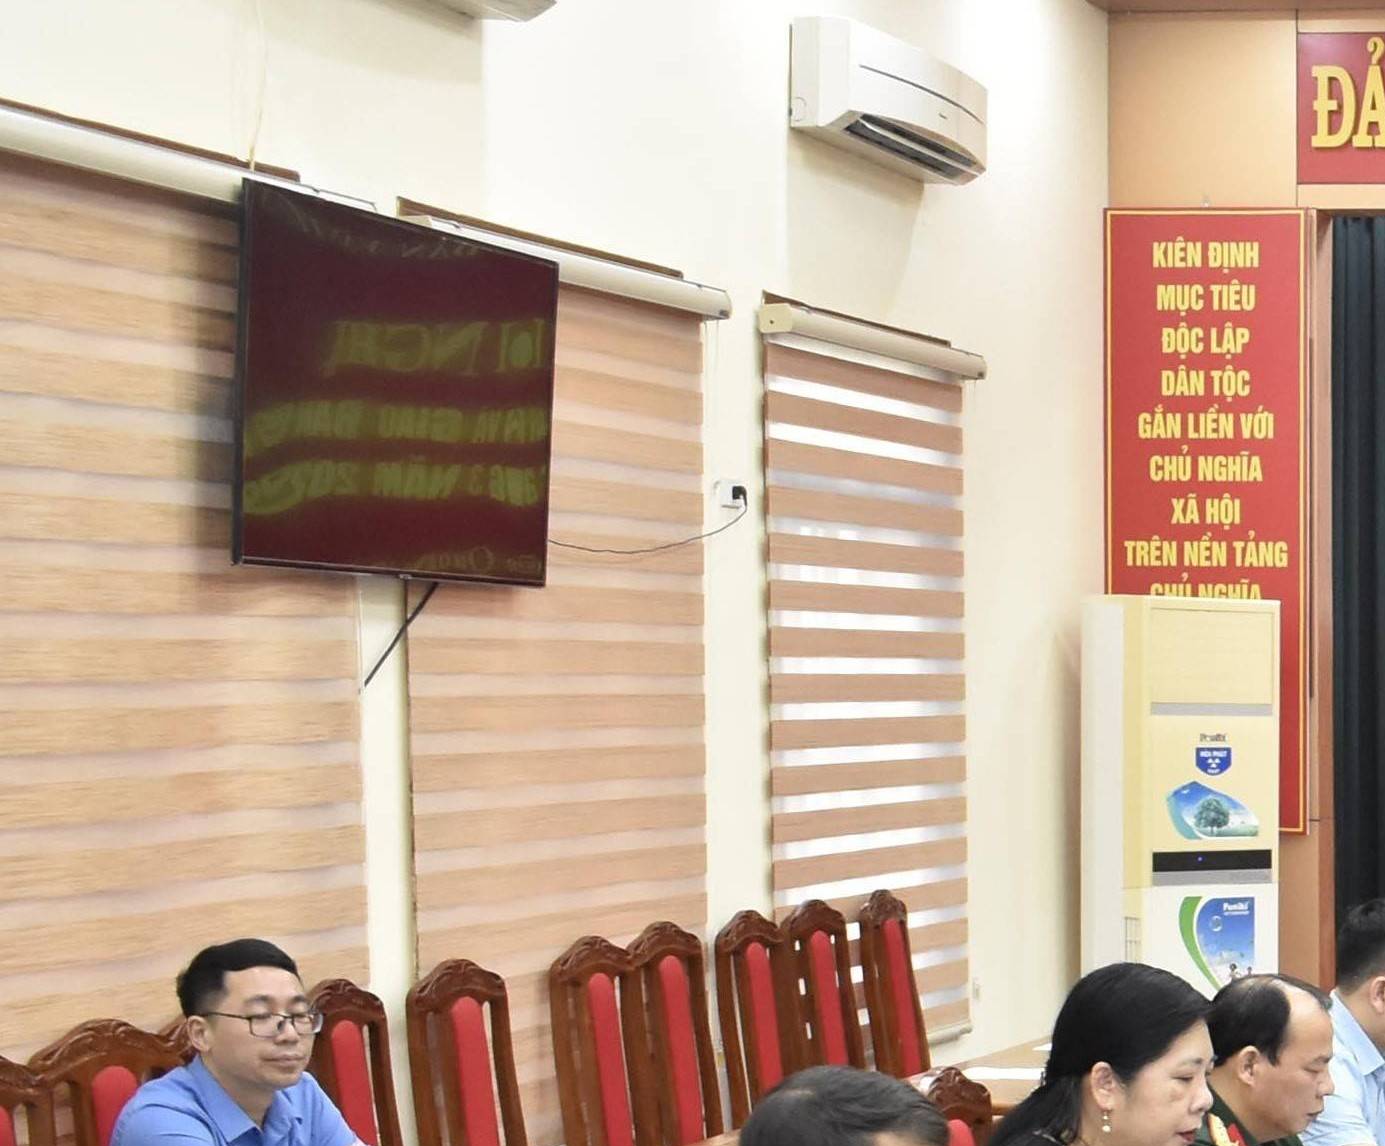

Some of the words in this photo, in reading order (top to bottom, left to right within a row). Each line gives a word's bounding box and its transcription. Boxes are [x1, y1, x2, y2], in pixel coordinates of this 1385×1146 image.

[1153, 236, 1202, 267] KIÊN
[1208, 242, 1259, 273] ĐỊNH
[1157, 284, 1204, 316] MỤC
[1210, 279, 1255, 311] TIÊU
[1162, 322, 1204, 359] ĐỘC
[1211, 322, 1250, 359] LẬP
[1162, 365, 1204, 396] DÂN
[1211, 365, 1250, 402] TỘC
[1139, 405, 1181, 438] GẮN
[1188, 404, 1233, 439] LIỀN
[1240, 406, 1274, 439] VỚI
[1150, 445, 1191, 481] CHỦ
[1198, 451, 1262, 481] NGHĨA
[1172, 494, 1199, 523] XÃ
[1206, 493, 1240, 529] HỘI
[1125, 536, 1177, 566] TRÊN
[1184, 532, 1226, 566] NỀN
[1233, 531, 1288, 567] TẢNG
